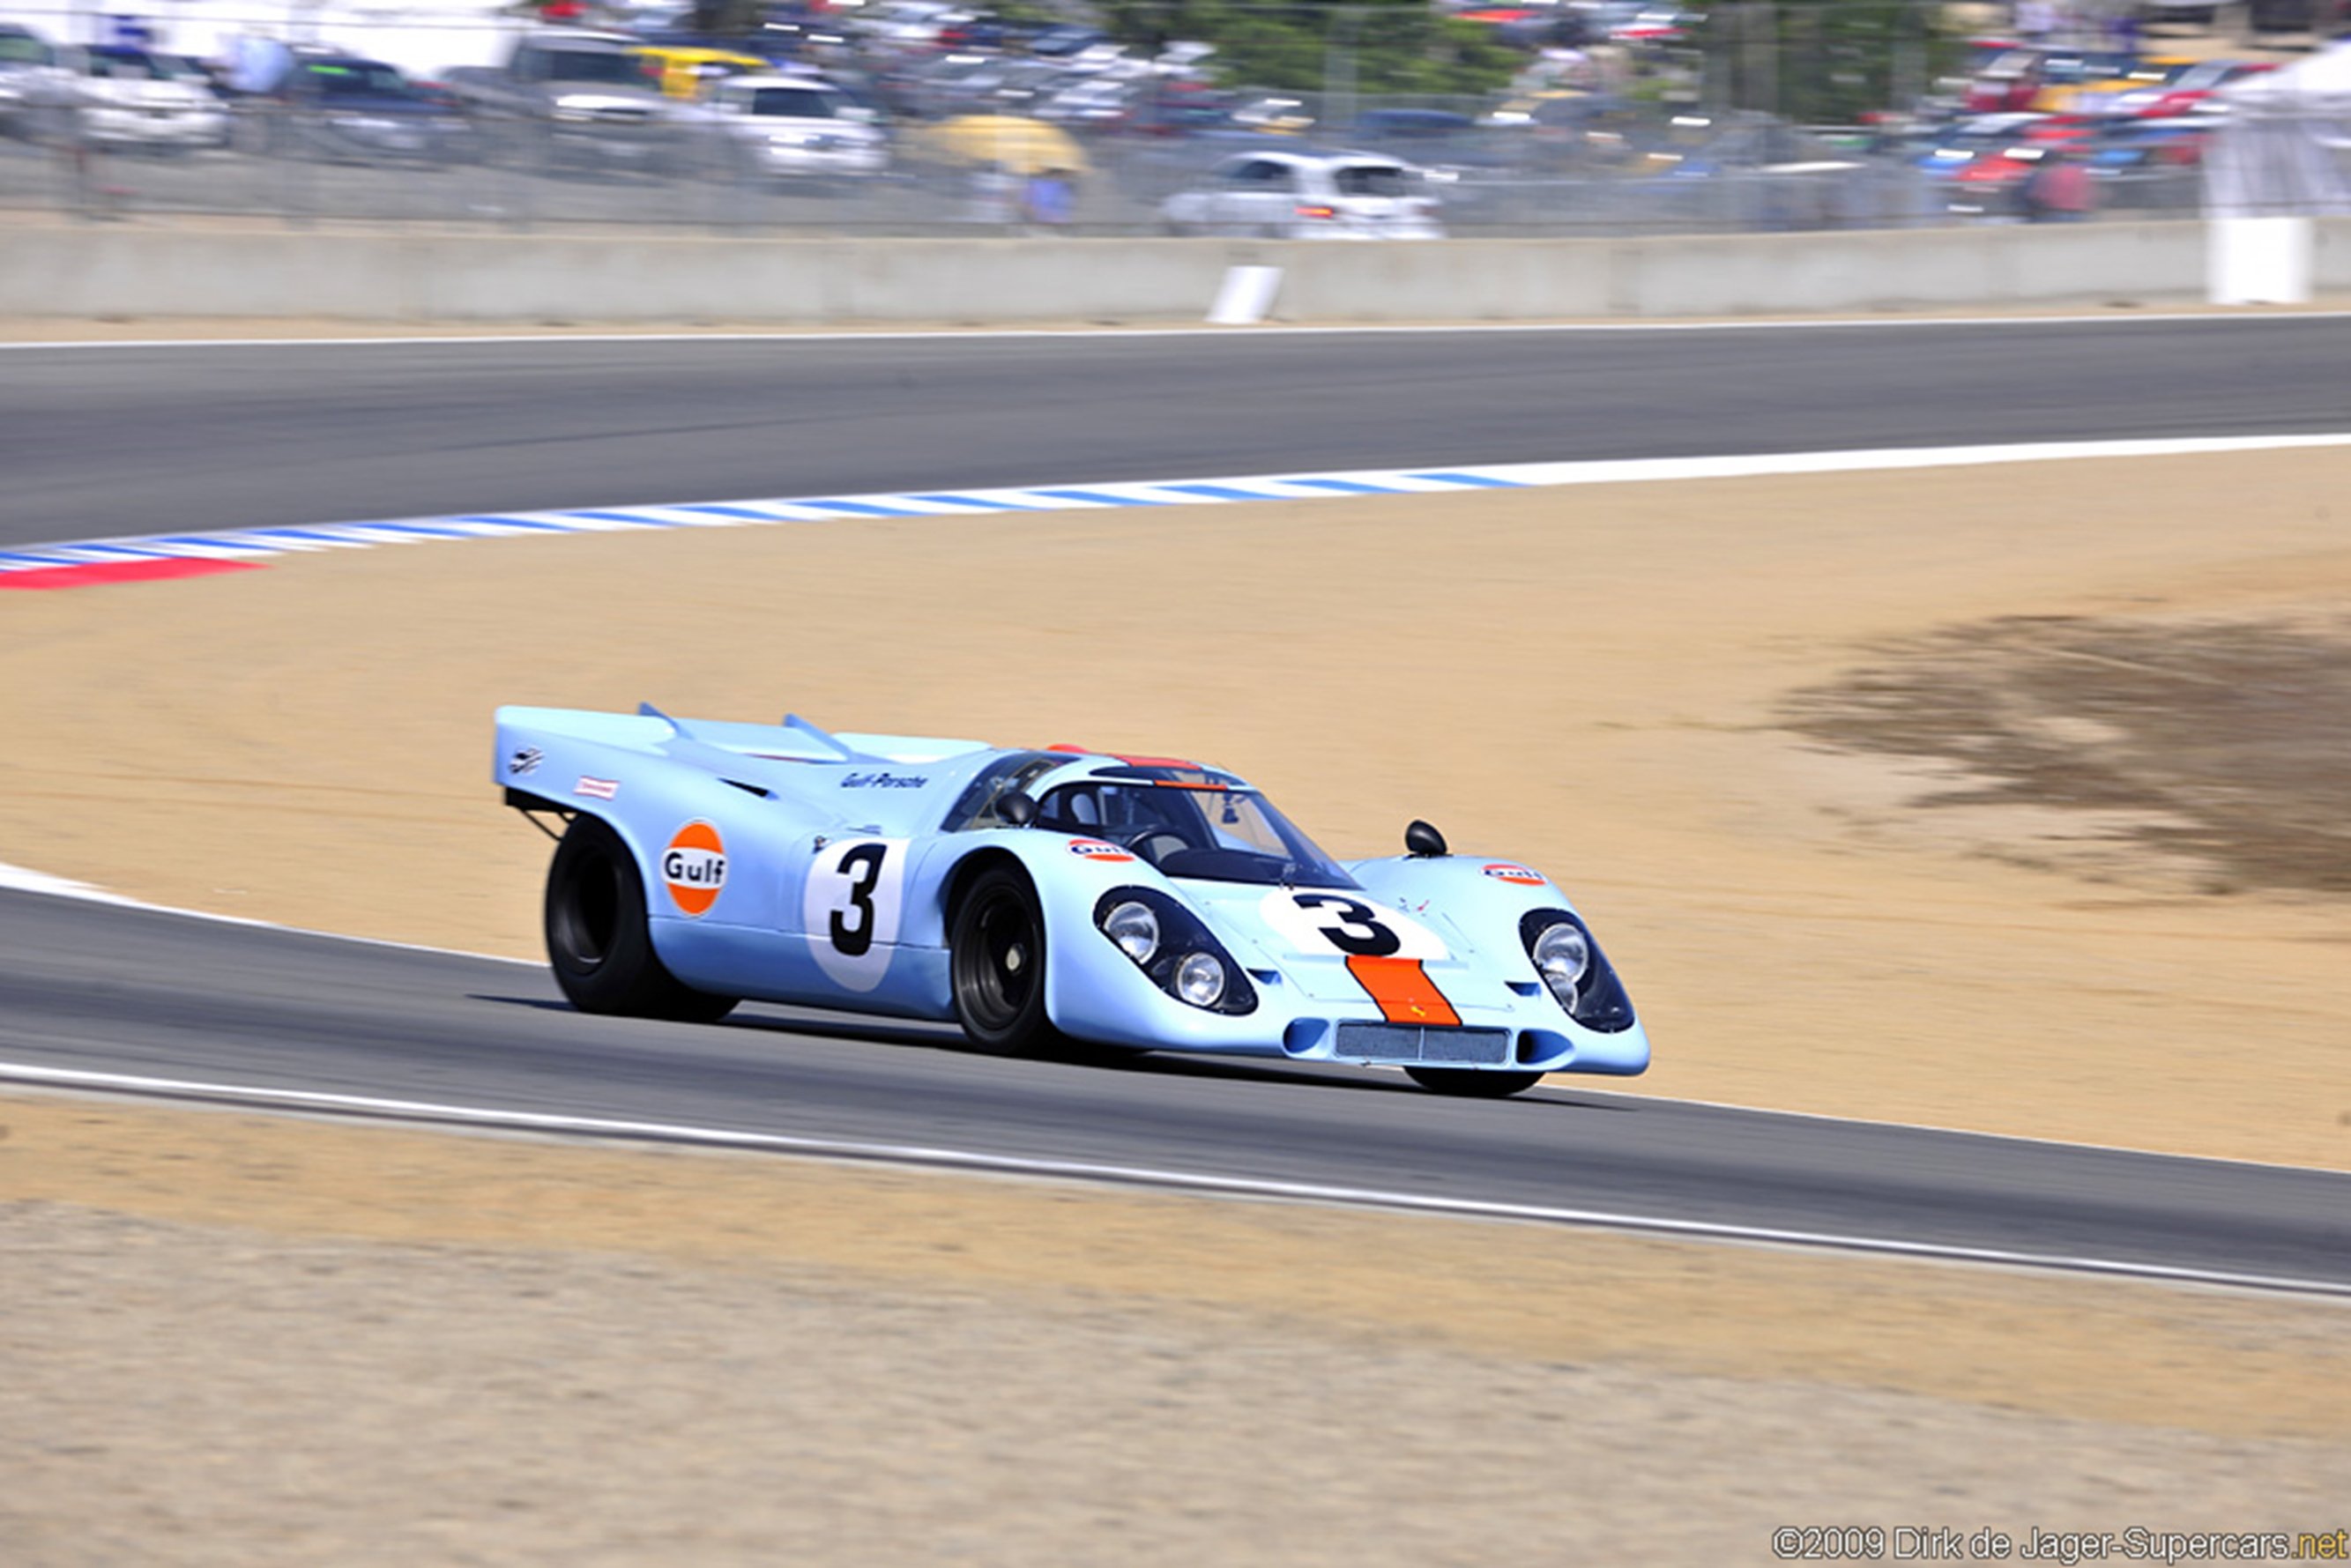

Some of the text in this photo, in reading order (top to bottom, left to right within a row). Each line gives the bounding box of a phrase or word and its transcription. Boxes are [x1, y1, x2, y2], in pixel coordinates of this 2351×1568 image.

[665, 851, 725, 884] Gulf
[830, 843, 888, 956] 3
[1292, 894, 1401, 956] 3
